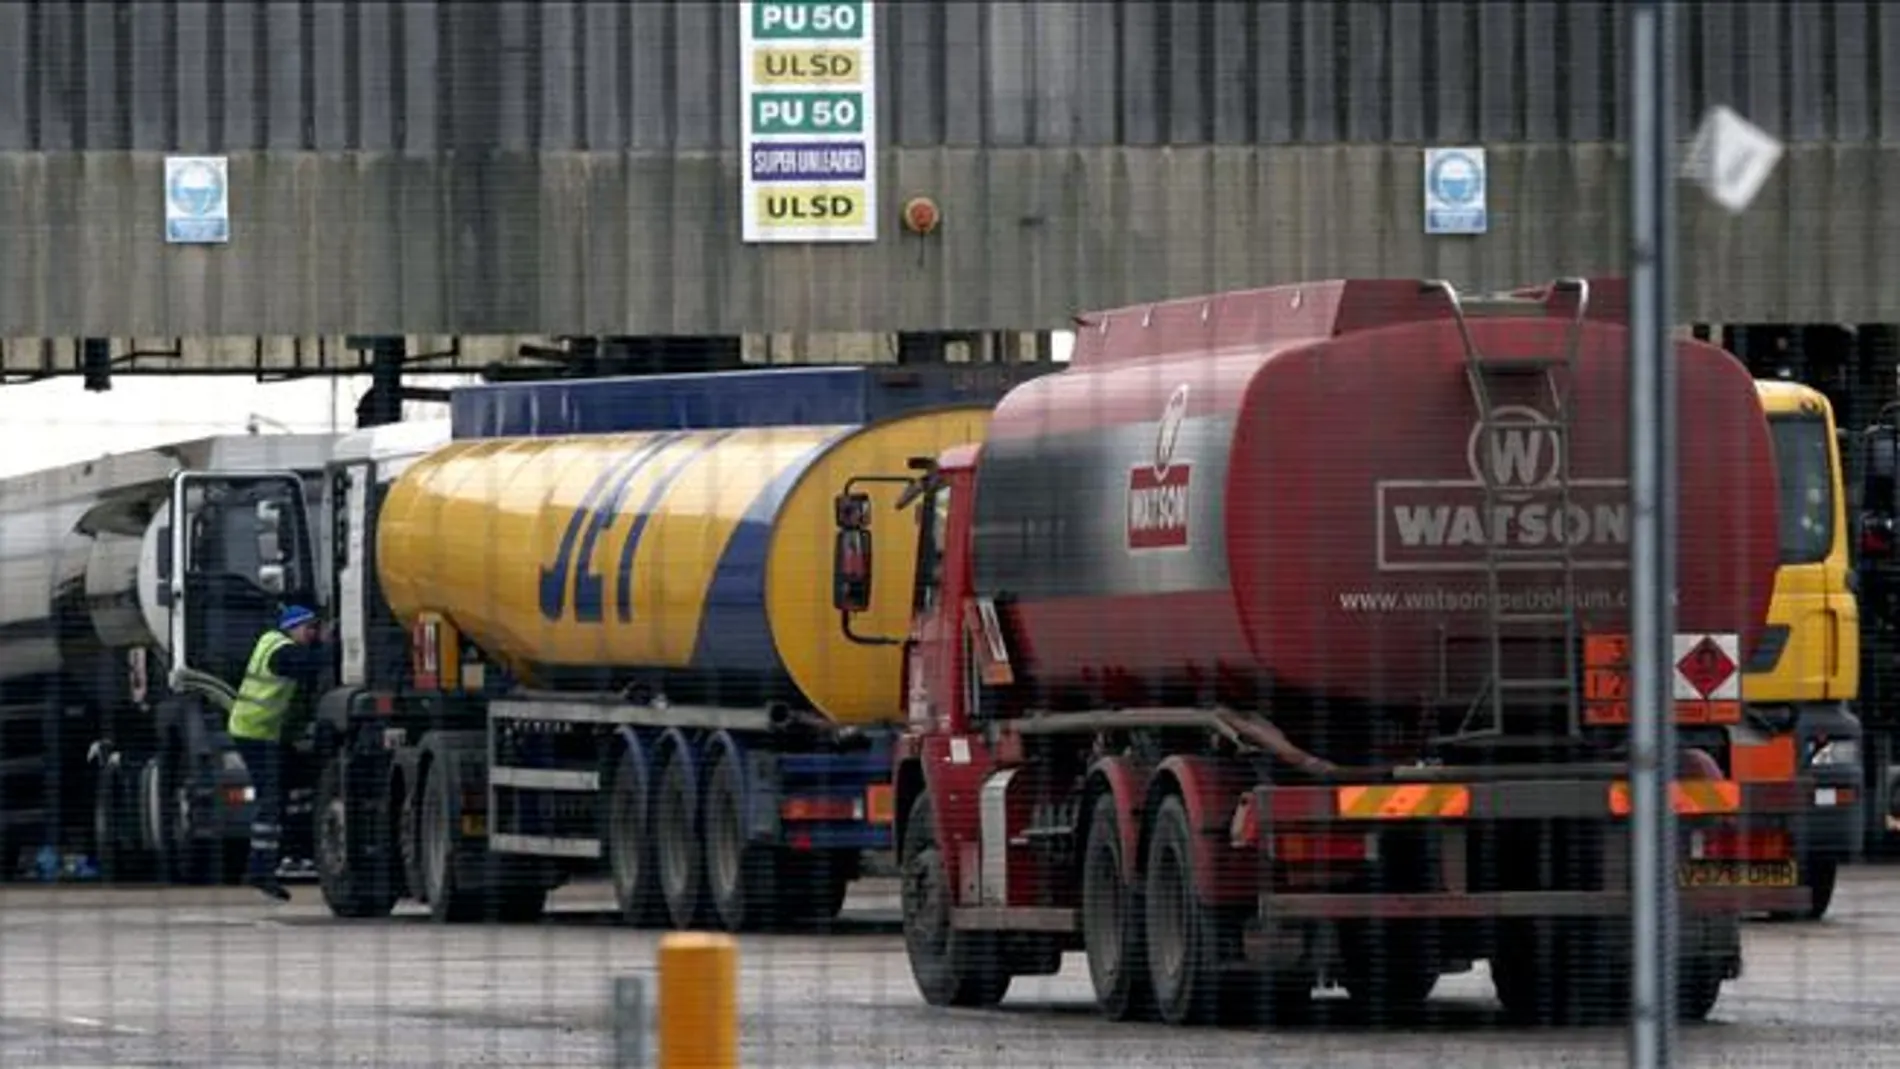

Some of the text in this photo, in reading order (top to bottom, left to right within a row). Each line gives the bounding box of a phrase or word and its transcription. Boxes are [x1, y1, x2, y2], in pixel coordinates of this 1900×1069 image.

[761, 5, 856, 31] PU 50
[765, 54, 852, 77] ULSD
[759, 99, 856, 126] PU 50
[754, 150, 797, 173] SUPER
[767, 195, 853, 219] ULSD
[1490, 429, 1543, 485] W
[538, 430, 737, 624] JET
[1393, 504, 1628, 546] WATSON
